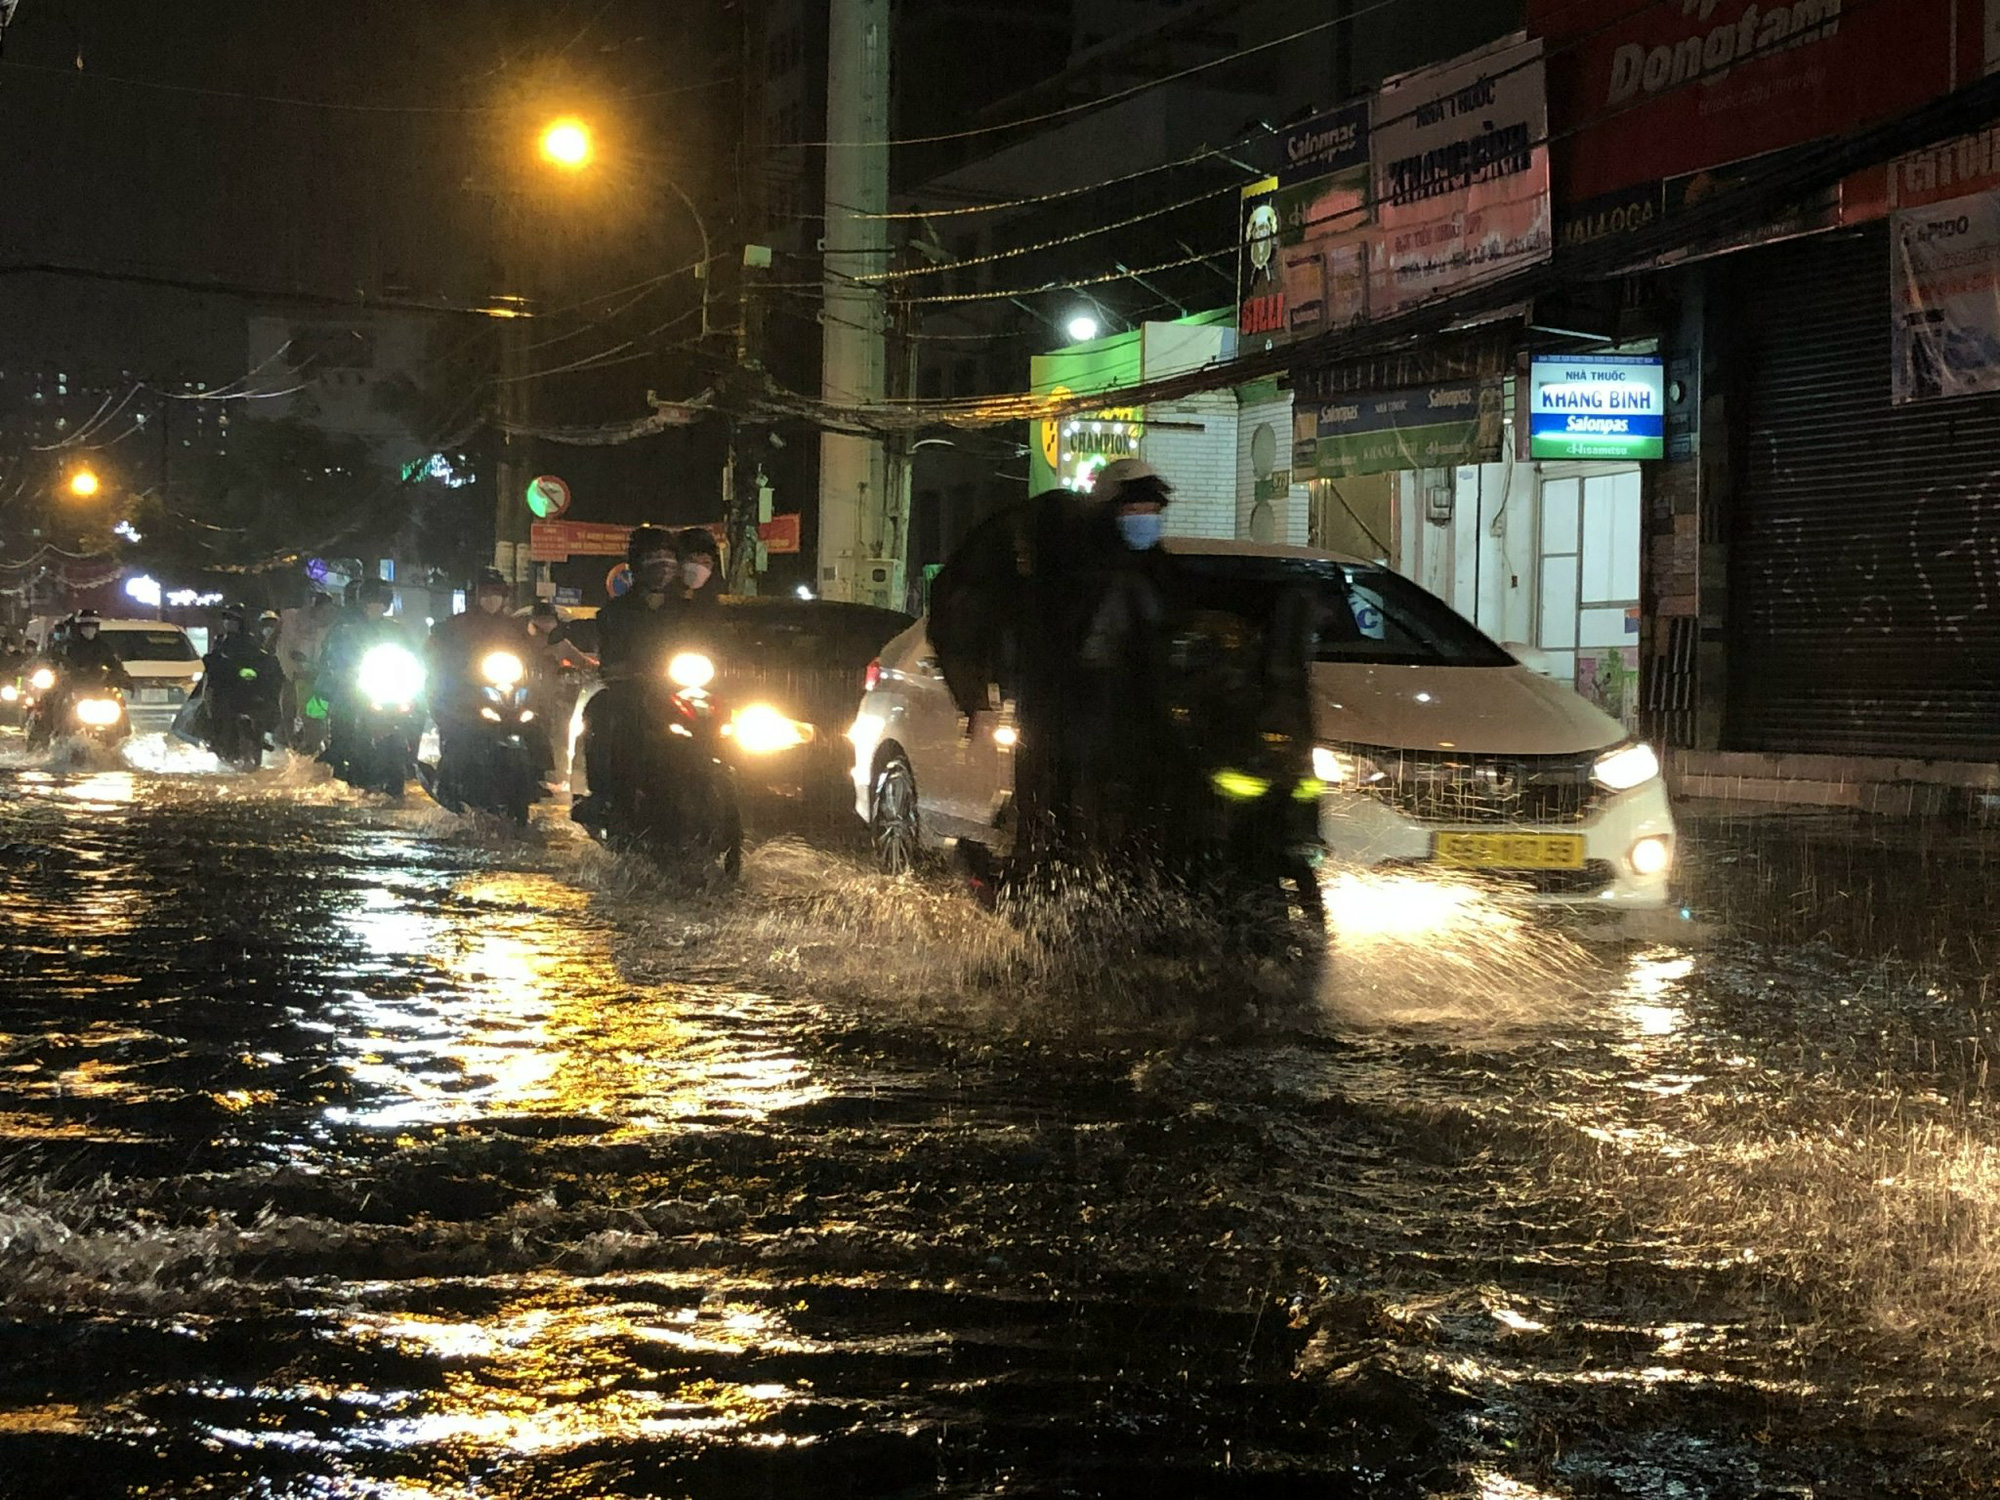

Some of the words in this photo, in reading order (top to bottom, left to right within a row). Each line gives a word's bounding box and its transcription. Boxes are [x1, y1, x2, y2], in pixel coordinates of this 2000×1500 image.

[1566, 369, 1587, 381] NHÀ
[1591, 369, 1626, 381] THUỐC
[1542, 390, 1603, 409] KHANG
[1566, 415, 1629, 434] Salonpas
[1070, 431, 1131, 456] CHAMPION
[1356, 608, 1378, 629] C
